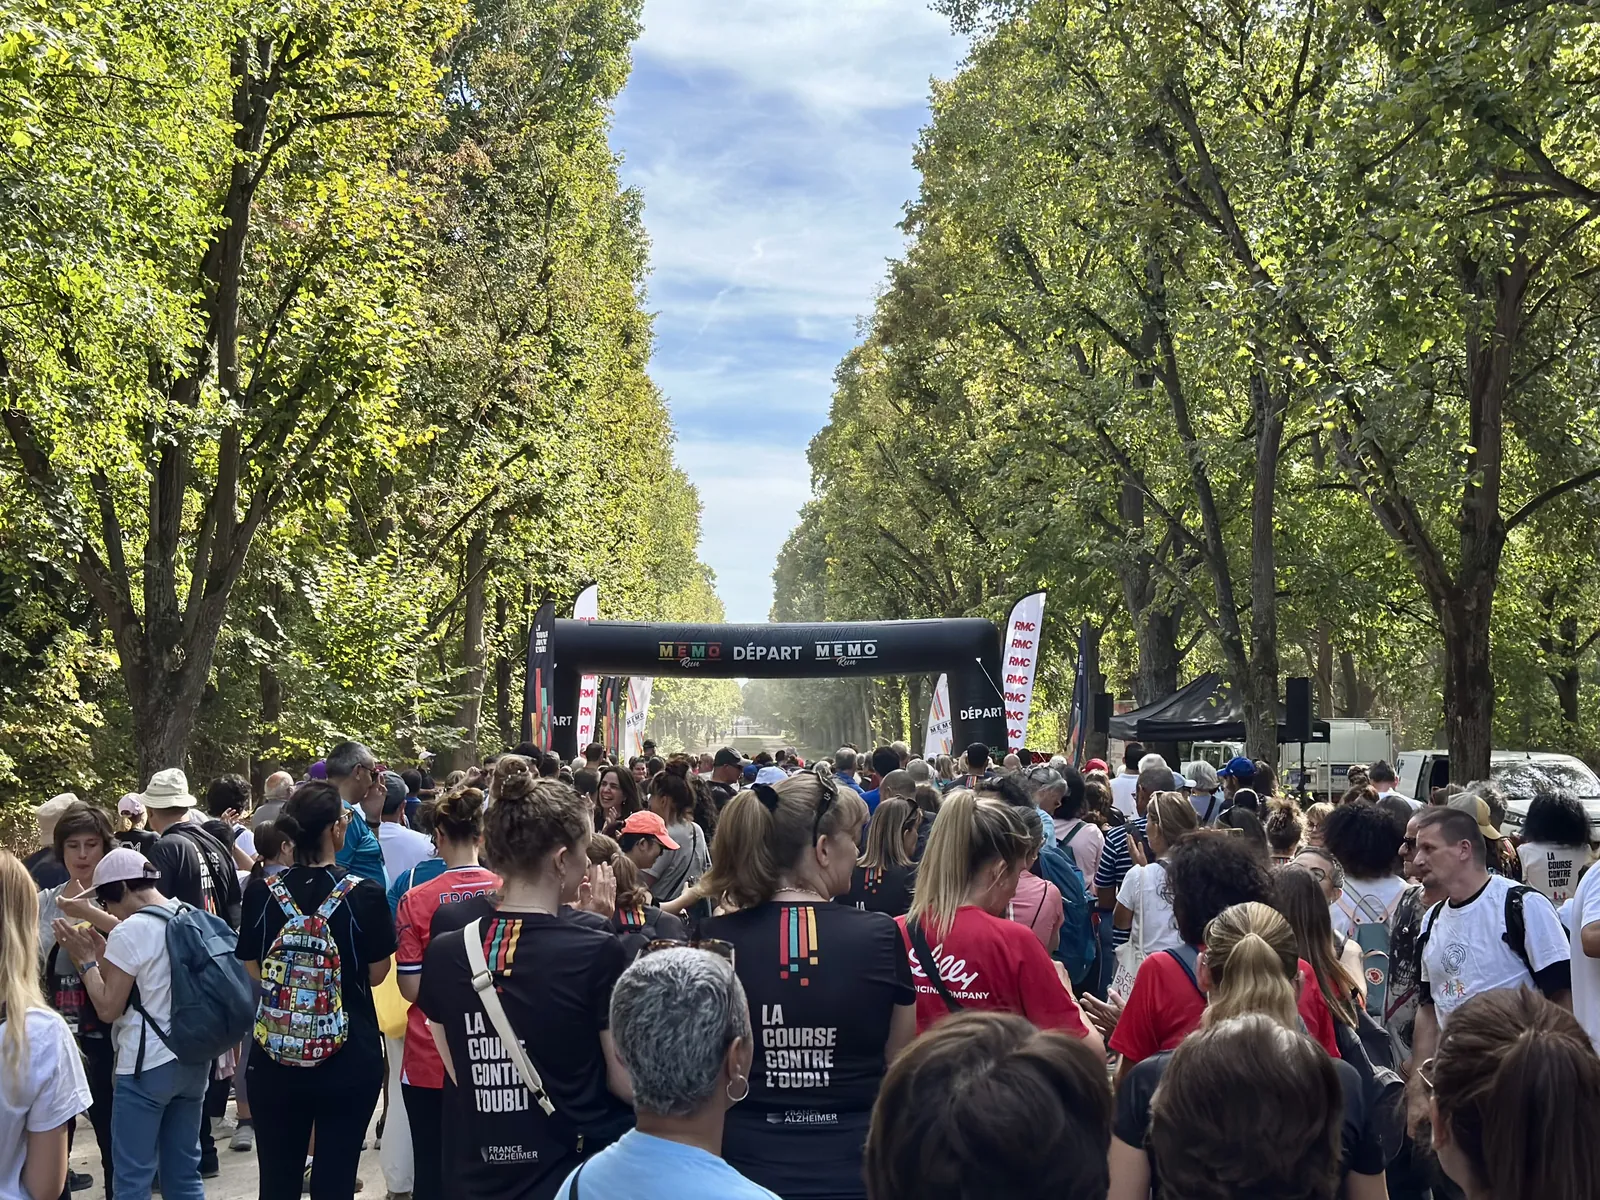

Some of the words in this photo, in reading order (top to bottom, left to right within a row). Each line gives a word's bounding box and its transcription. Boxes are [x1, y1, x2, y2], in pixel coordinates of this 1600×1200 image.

[1014, 621, 1036, 632] RMC
[1011, 639, 1033, 650] RMC
[659, 644, 720, 658] MEMO
[733, 642, 802, 660] DÉPART
[816, 643, 876, 657] MEMO
[680, 656, 700, 668] Run
[836, 656, 856, 667] Run
[1008, 656, 1031, 667] RMC
[1006, 674, 1029, 685] RMC
[1004, 692, 1026, 703] RMC
[960, 706, 1003, 720] DÉPART
[1547, 852, 1555, 860] LA
[1548, 860, 1572, 869] COURSE
[1548, 870, 1571, 878] CONTRE
[762, 1004, 784, 1025] LA
[464, 1012, 486, 1035] LA
[762, 1027, 837, 1048] COURSE
[765, 1049, 834, 1069] CONTRE
[471, 1062, 524, 1086] CONTR
[475, 1088, 528, 1112] L'OUBLI
[785, 1113, 837, 1122] ALZHEIMER
[489, 1145, 522, 1153] FRANCE
[489, 1151, 538, 1161] ALZHEIMER
